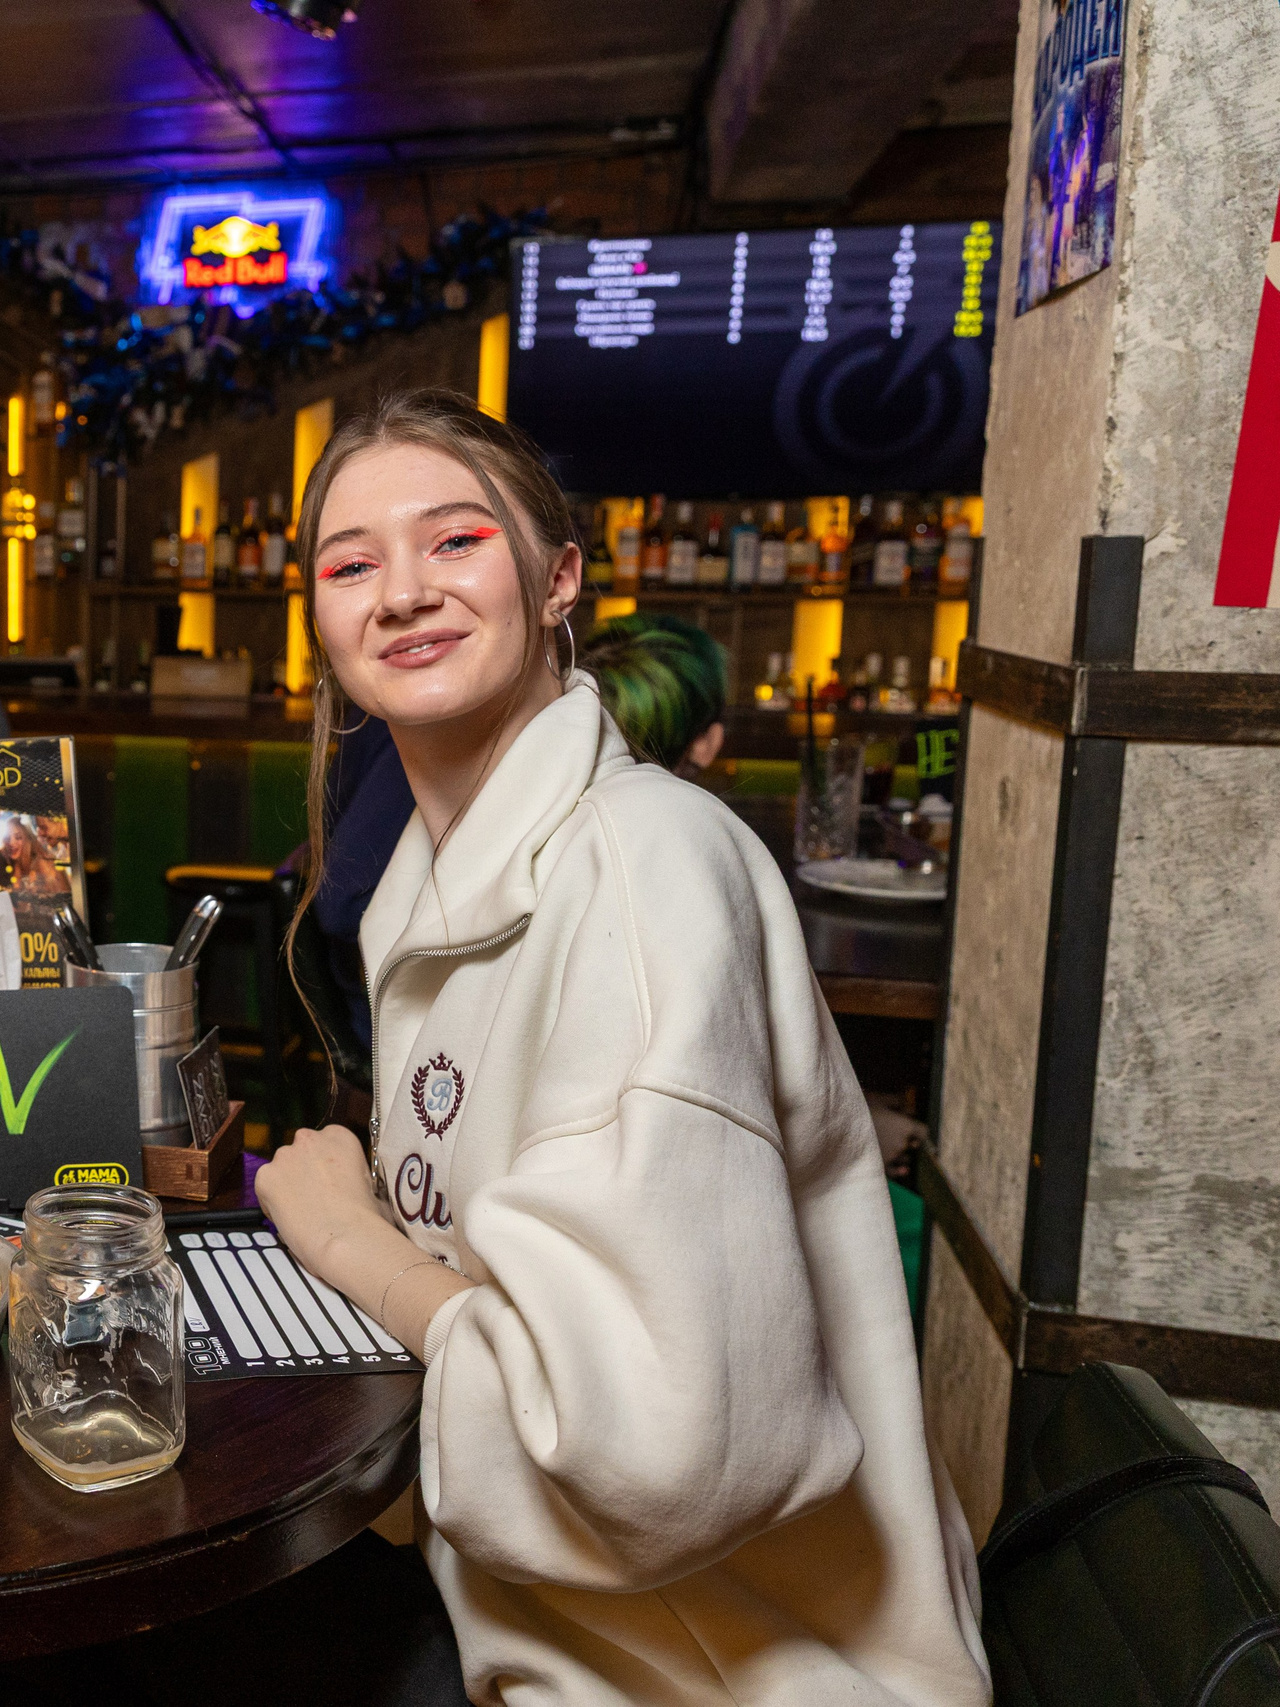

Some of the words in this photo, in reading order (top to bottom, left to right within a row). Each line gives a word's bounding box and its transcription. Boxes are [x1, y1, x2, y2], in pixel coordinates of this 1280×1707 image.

[208, 1336, 231, 1365] МНЕНИЙ
[185, 1337, 223, 1376] 100
[332, 1356, 350, 1364] 4
[363, 1355, 382, 1363] 5
[391, 1354, 411, 1362] 6
[275, 1359, 296, 1367] 2
[304, 1357, 324, 1366] 3
